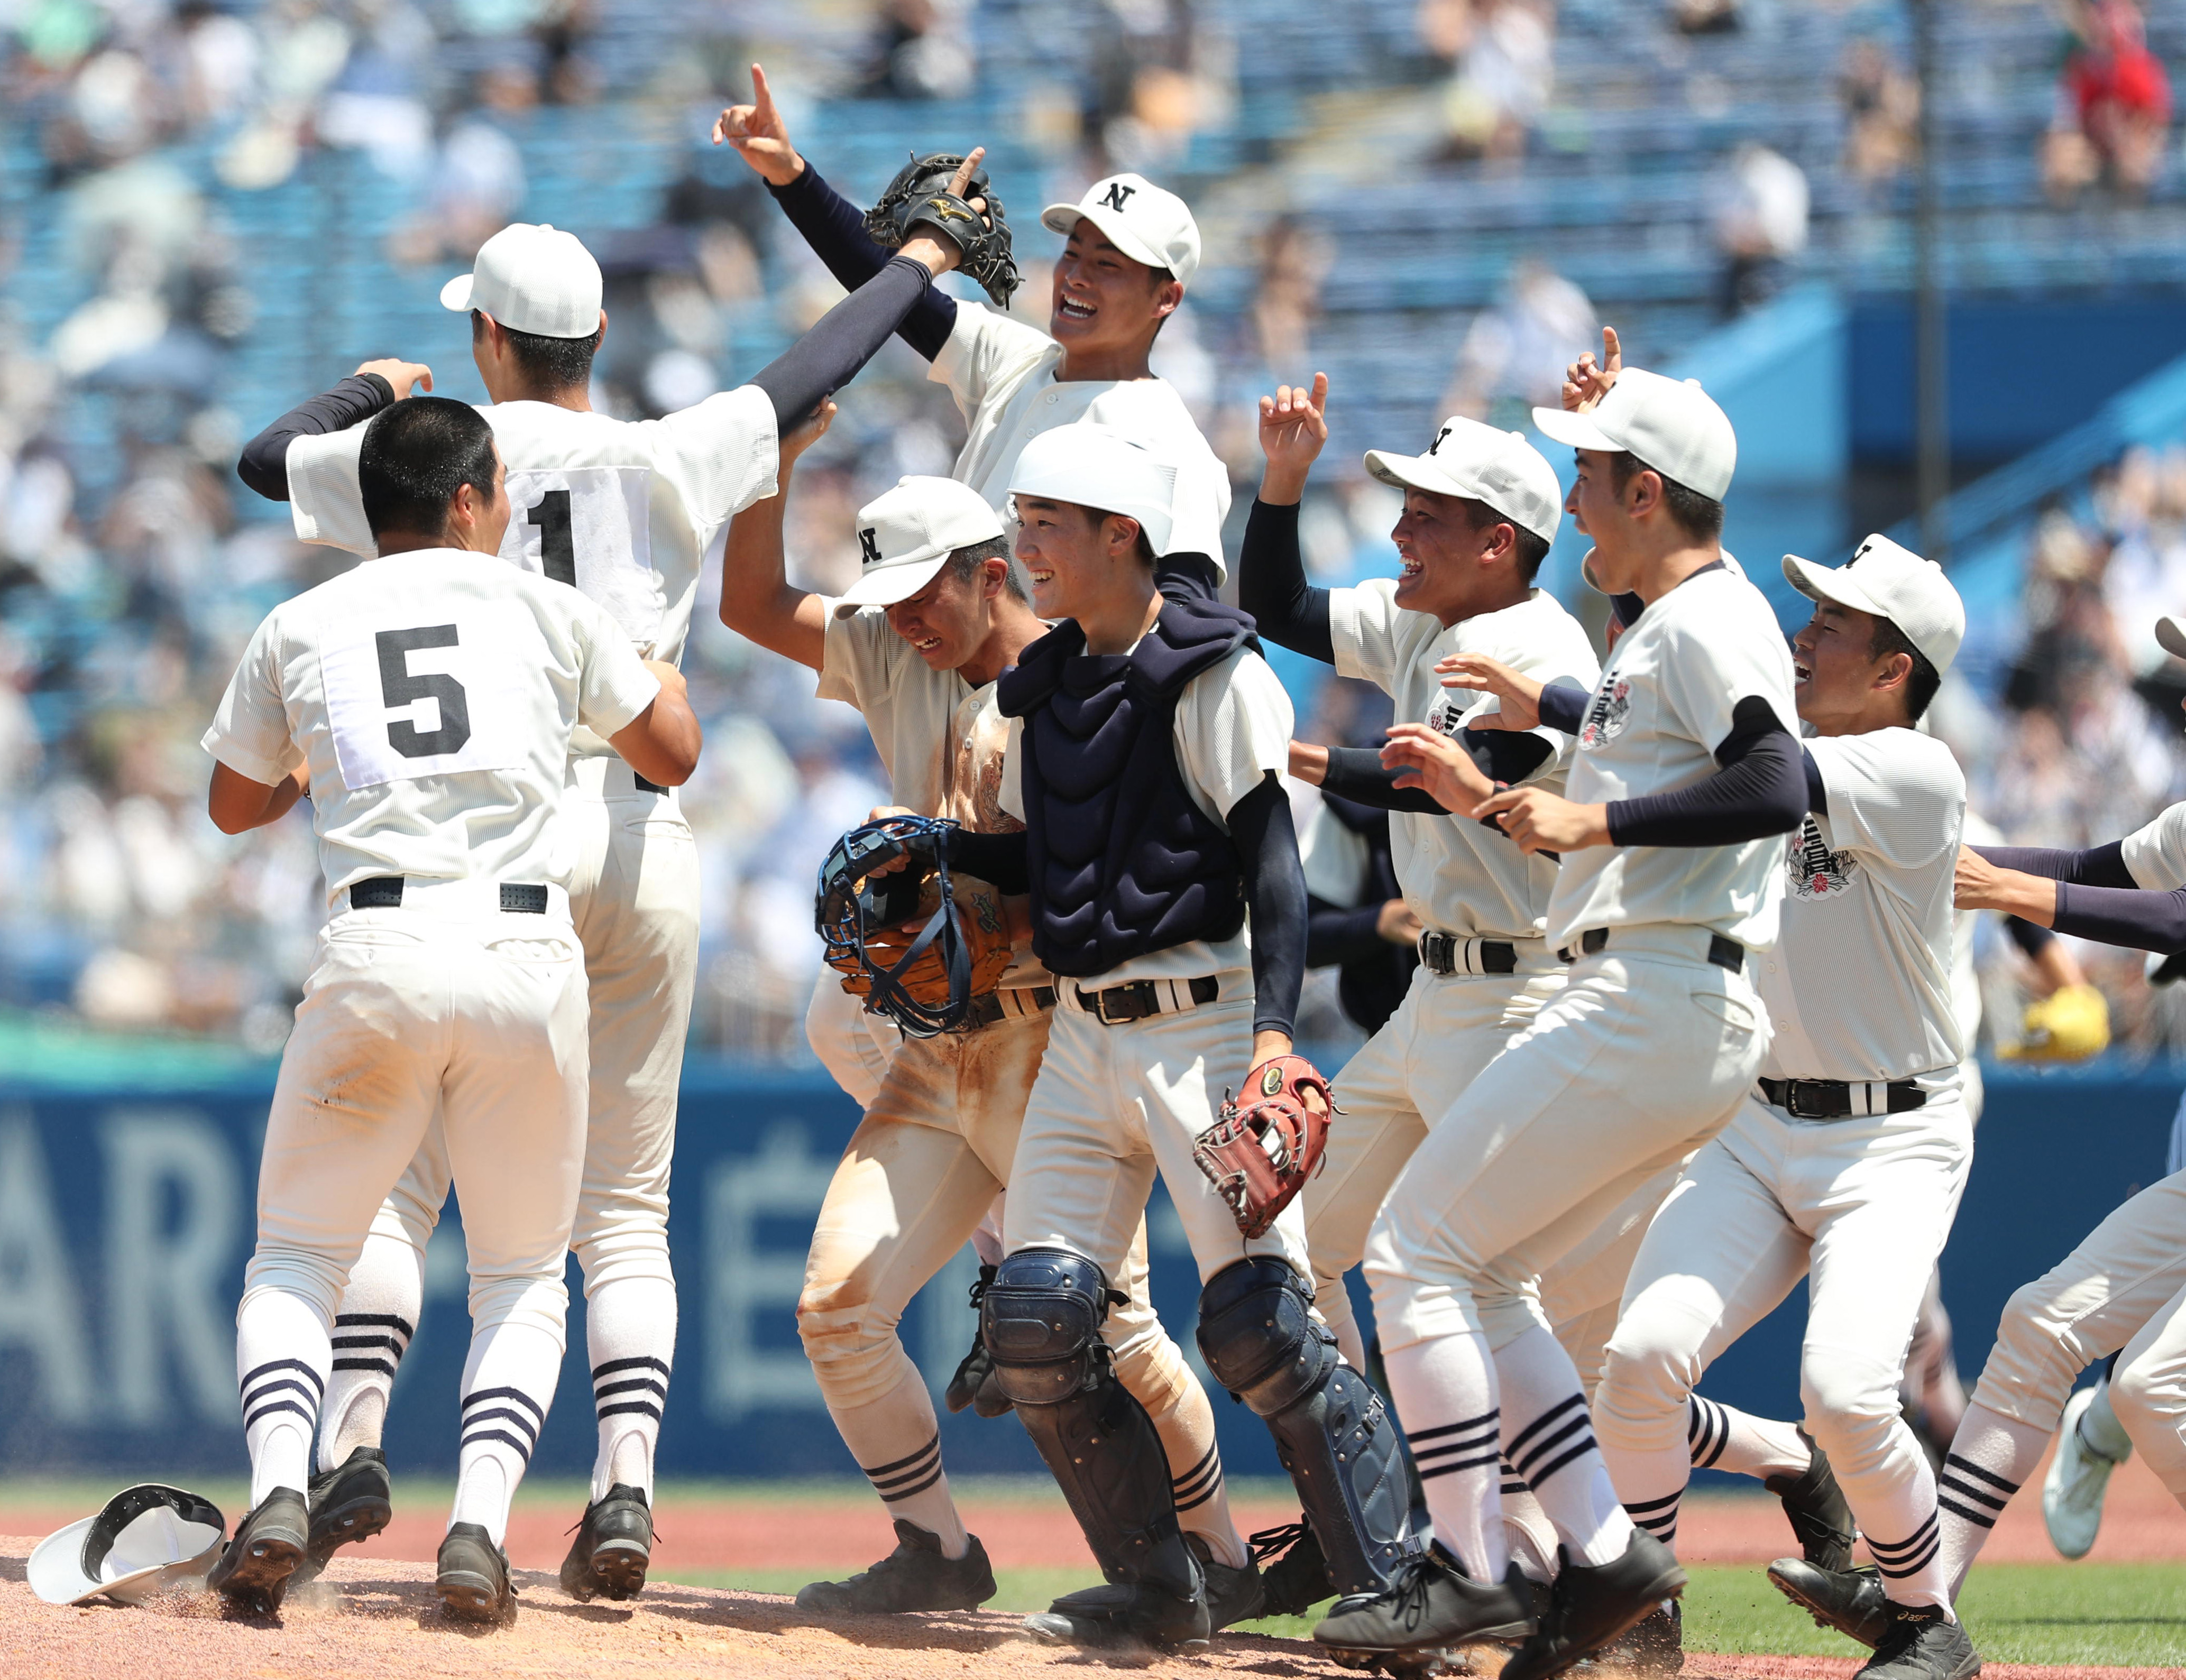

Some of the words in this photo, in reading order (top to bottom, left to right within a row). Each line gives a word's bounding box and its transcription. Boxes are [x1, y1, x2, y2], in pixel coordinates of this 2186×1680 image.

[1097, 183, 1136, 213] N
[528, 490, 576, 588] 1
[858, 527, 883, 564] N
[375, 624, 472, 758] 5
